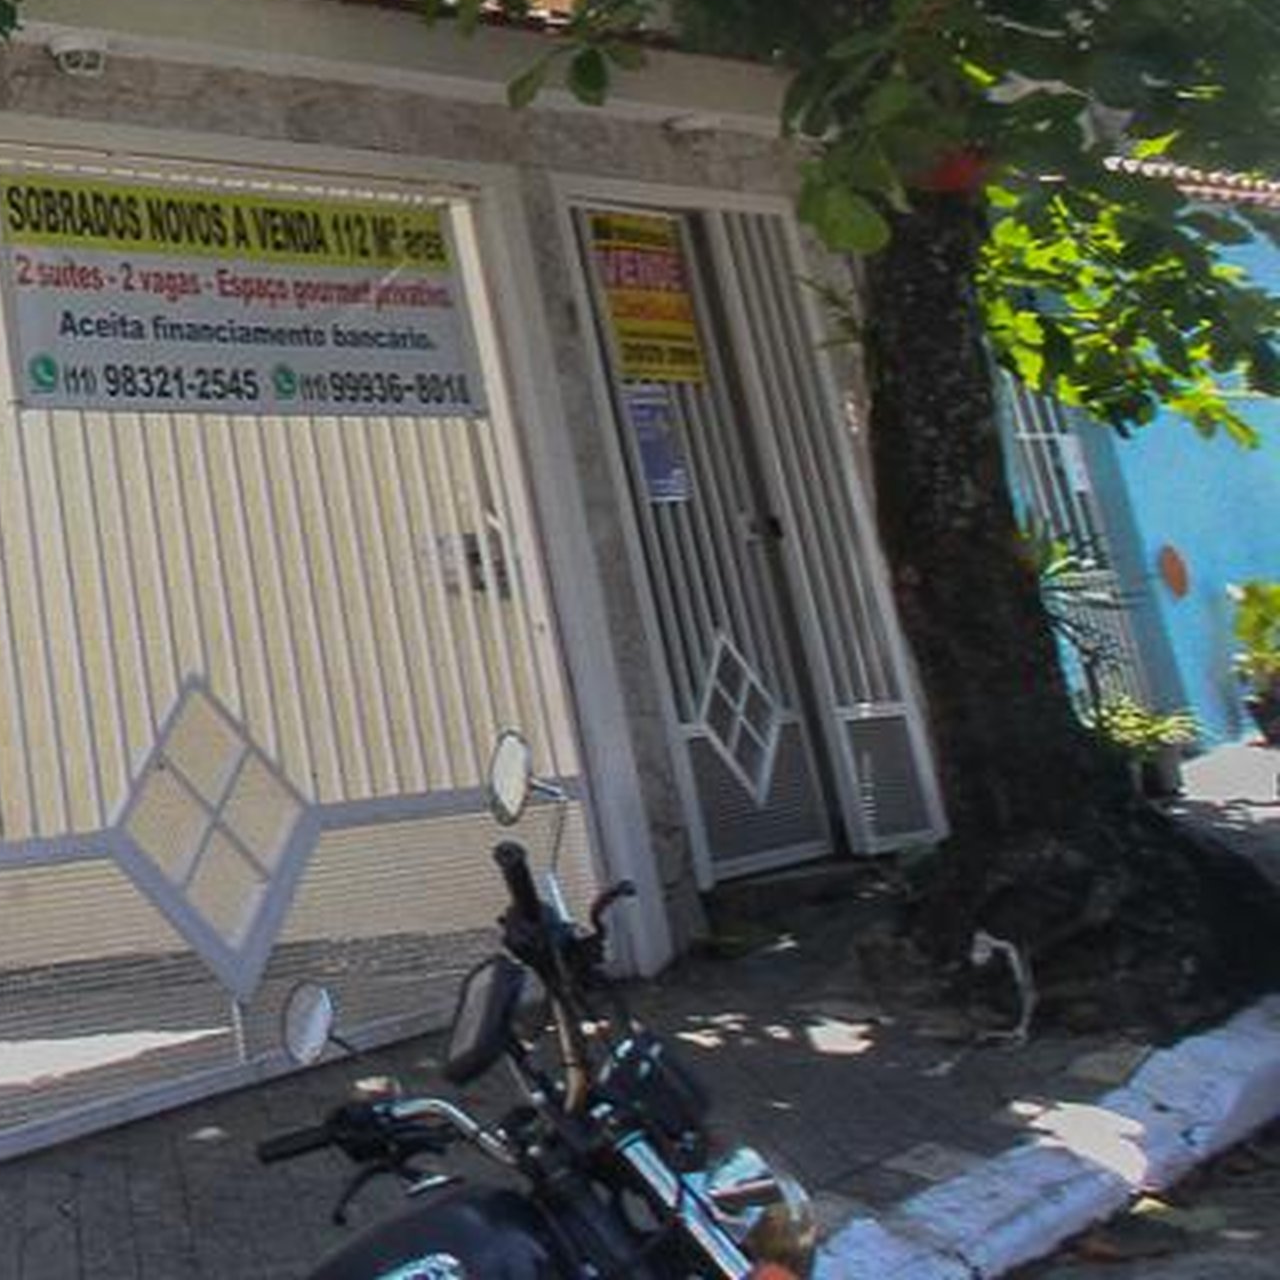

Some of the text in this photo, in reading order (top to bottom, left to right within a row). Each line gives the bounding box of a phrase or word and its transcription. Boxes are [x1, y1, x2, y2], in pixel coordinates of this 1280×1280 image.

[6, 186, 143, 241] SOBRADOS
[146, 198, 227, 247] NOVOS
[232, 206, 250, 249] A
[250, 208, 330, 255] VENDA
[332, 213, 370, 258] 112
[14, 254, 33, 285] 2
[120, 263, 135, 291] 2
[141, 269, 202, 302] vagas
[215, 269, 288, 308] Espaço
[59, 311, 145, 340] Aceita
[153, 315, 327, 348] financiamento
[104, 362, 260, 402] 98321-2545
